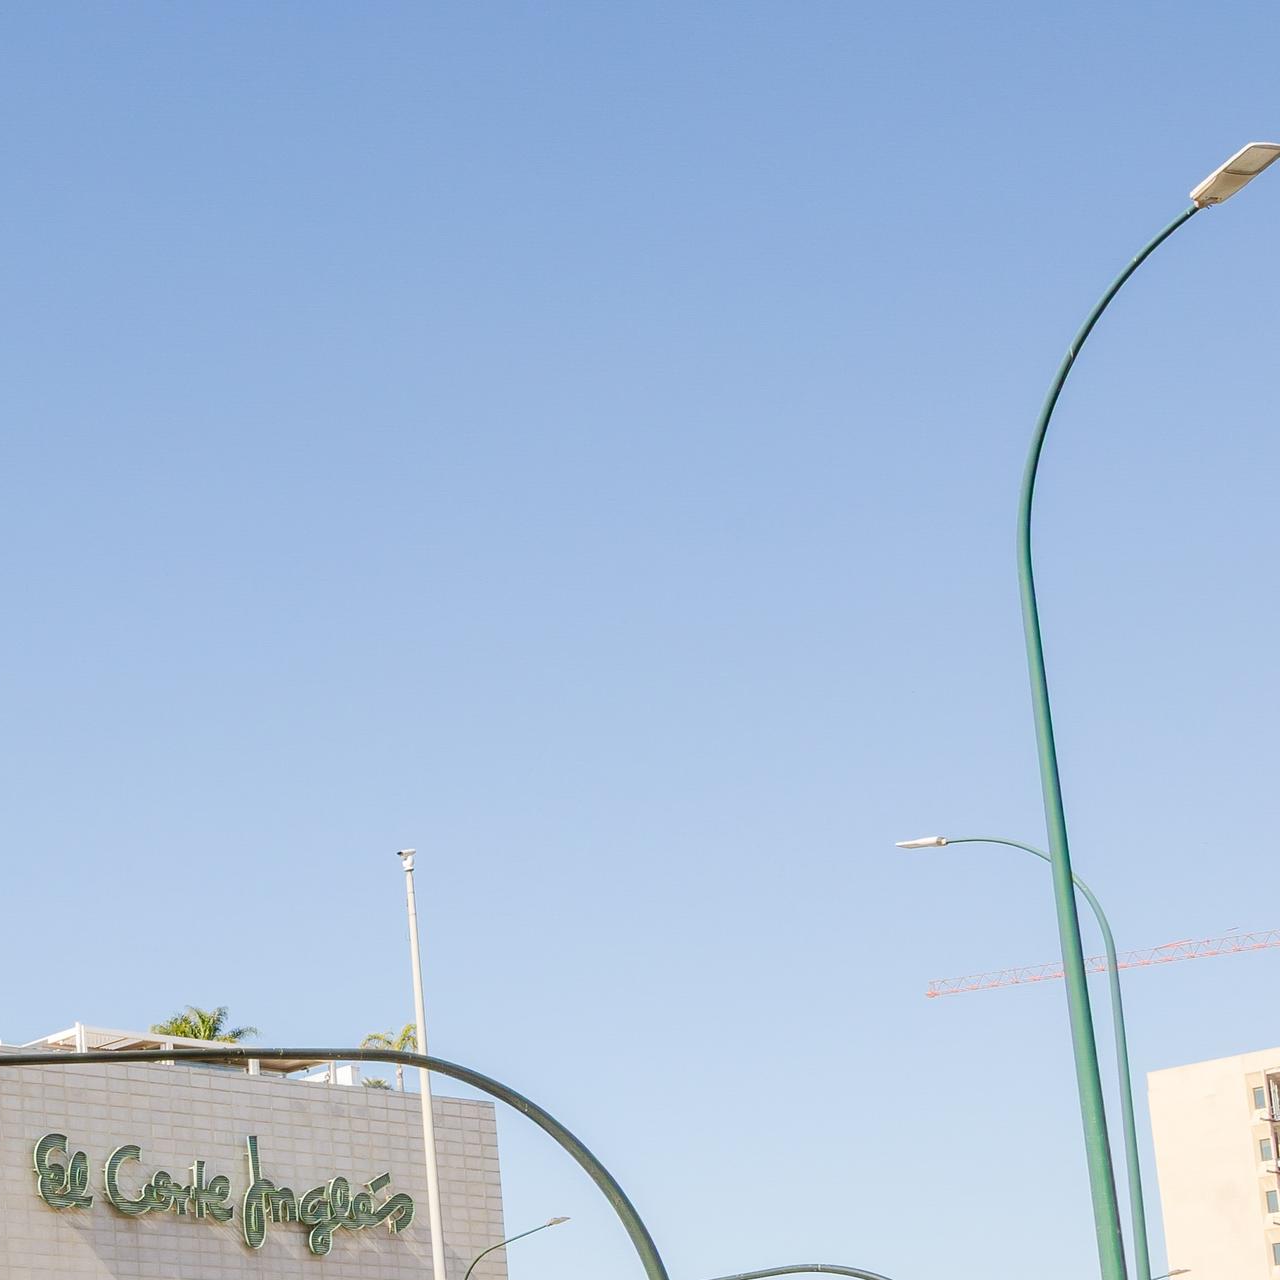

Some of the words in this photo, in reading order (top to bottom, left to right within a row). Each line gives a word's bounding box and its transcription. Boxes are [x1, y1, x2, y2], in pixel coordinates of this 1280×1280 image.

[33, 1133, 93, 1209] El
[103, 1144, 234, 1222] Corte
[244, 1135, 414, 1256] Inglés
